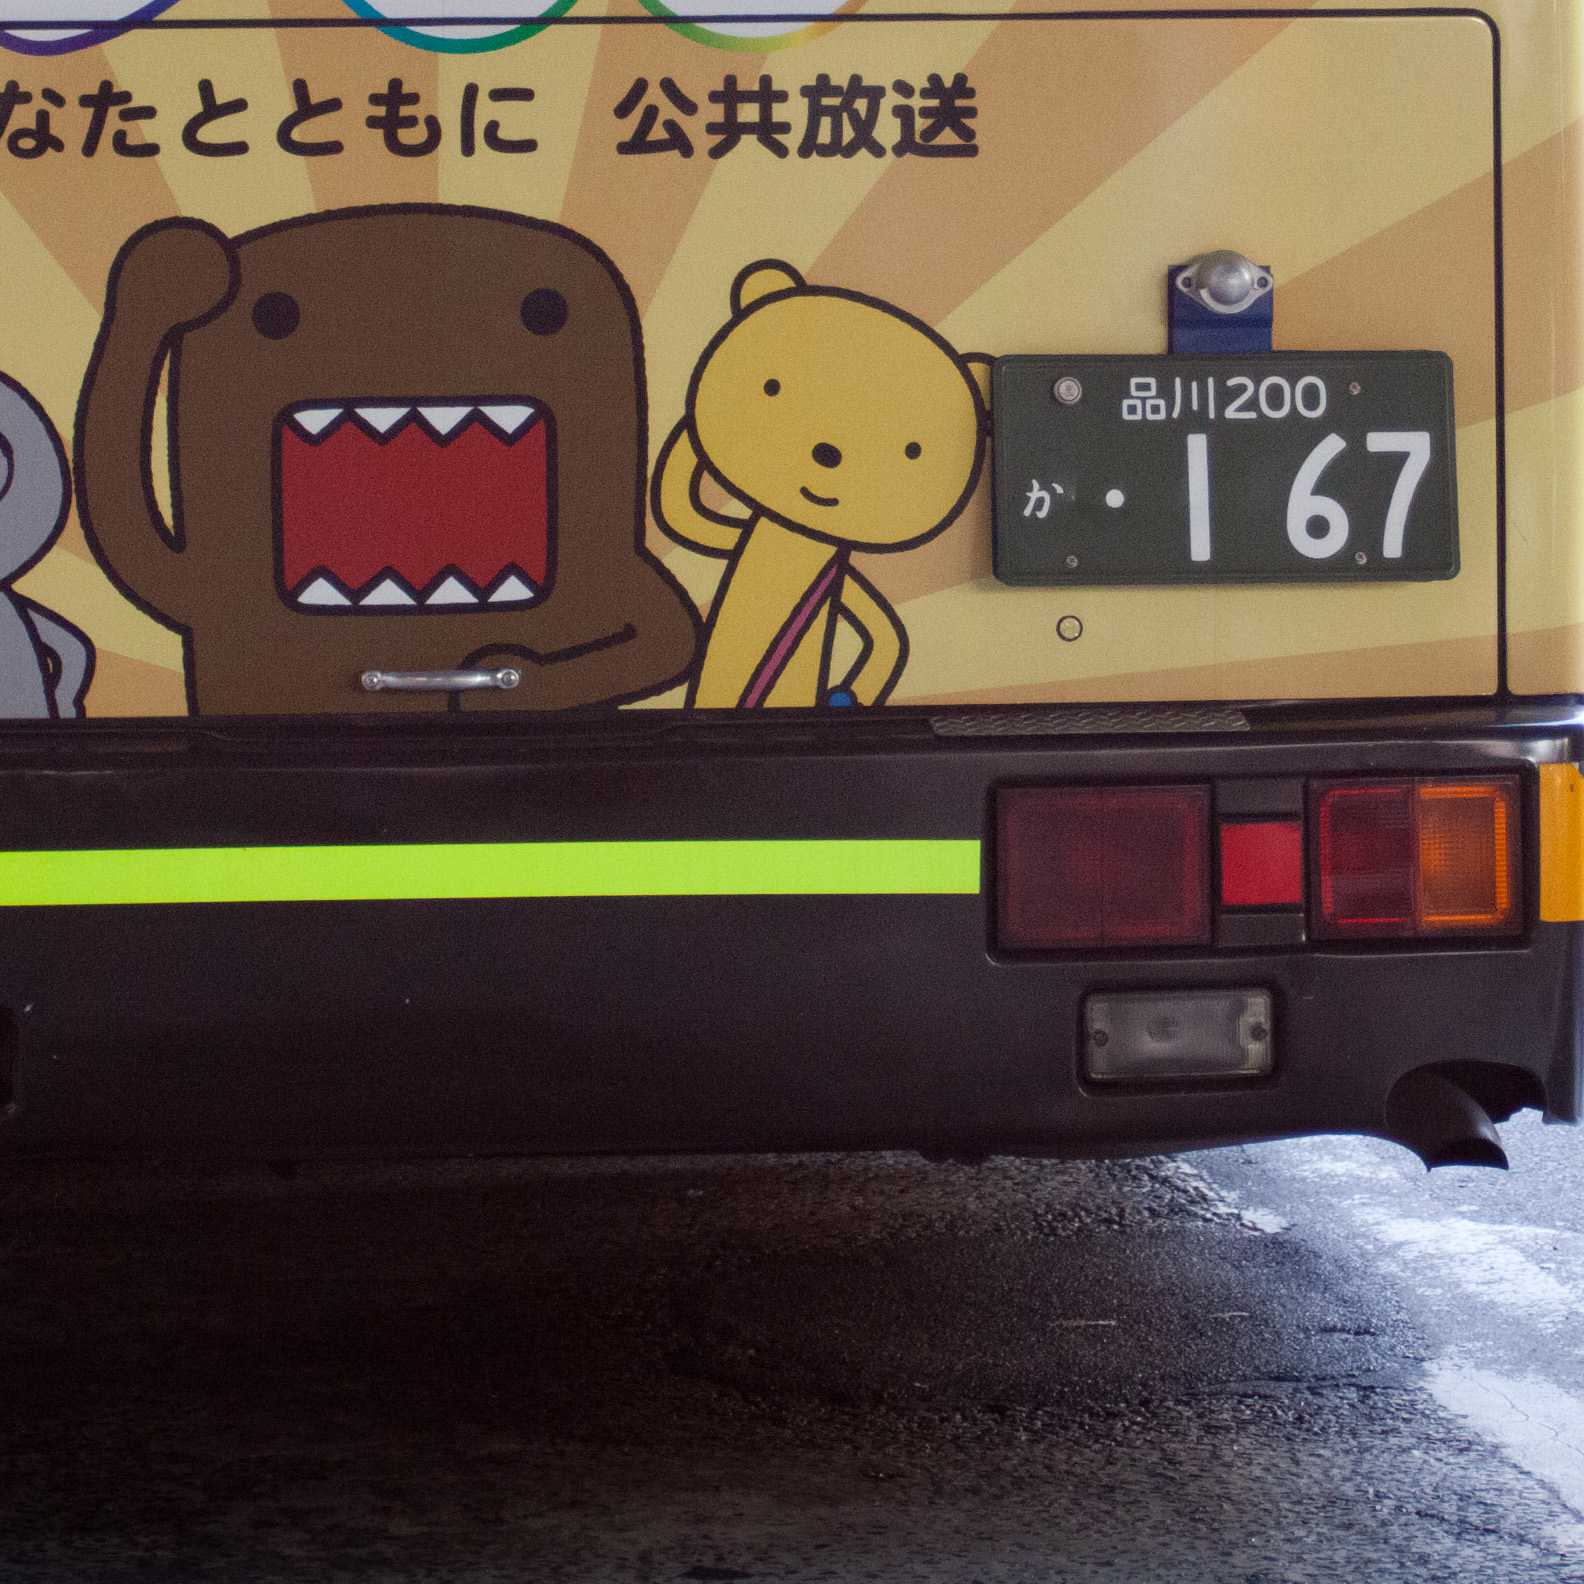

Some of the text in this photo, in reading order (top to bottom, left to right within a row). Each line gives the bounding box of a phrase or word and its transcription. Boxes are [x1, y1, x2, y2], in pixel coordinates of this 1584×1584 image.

[614, 72, 982, 164] 公共放送
[1022, 478, 1064, 519] か
